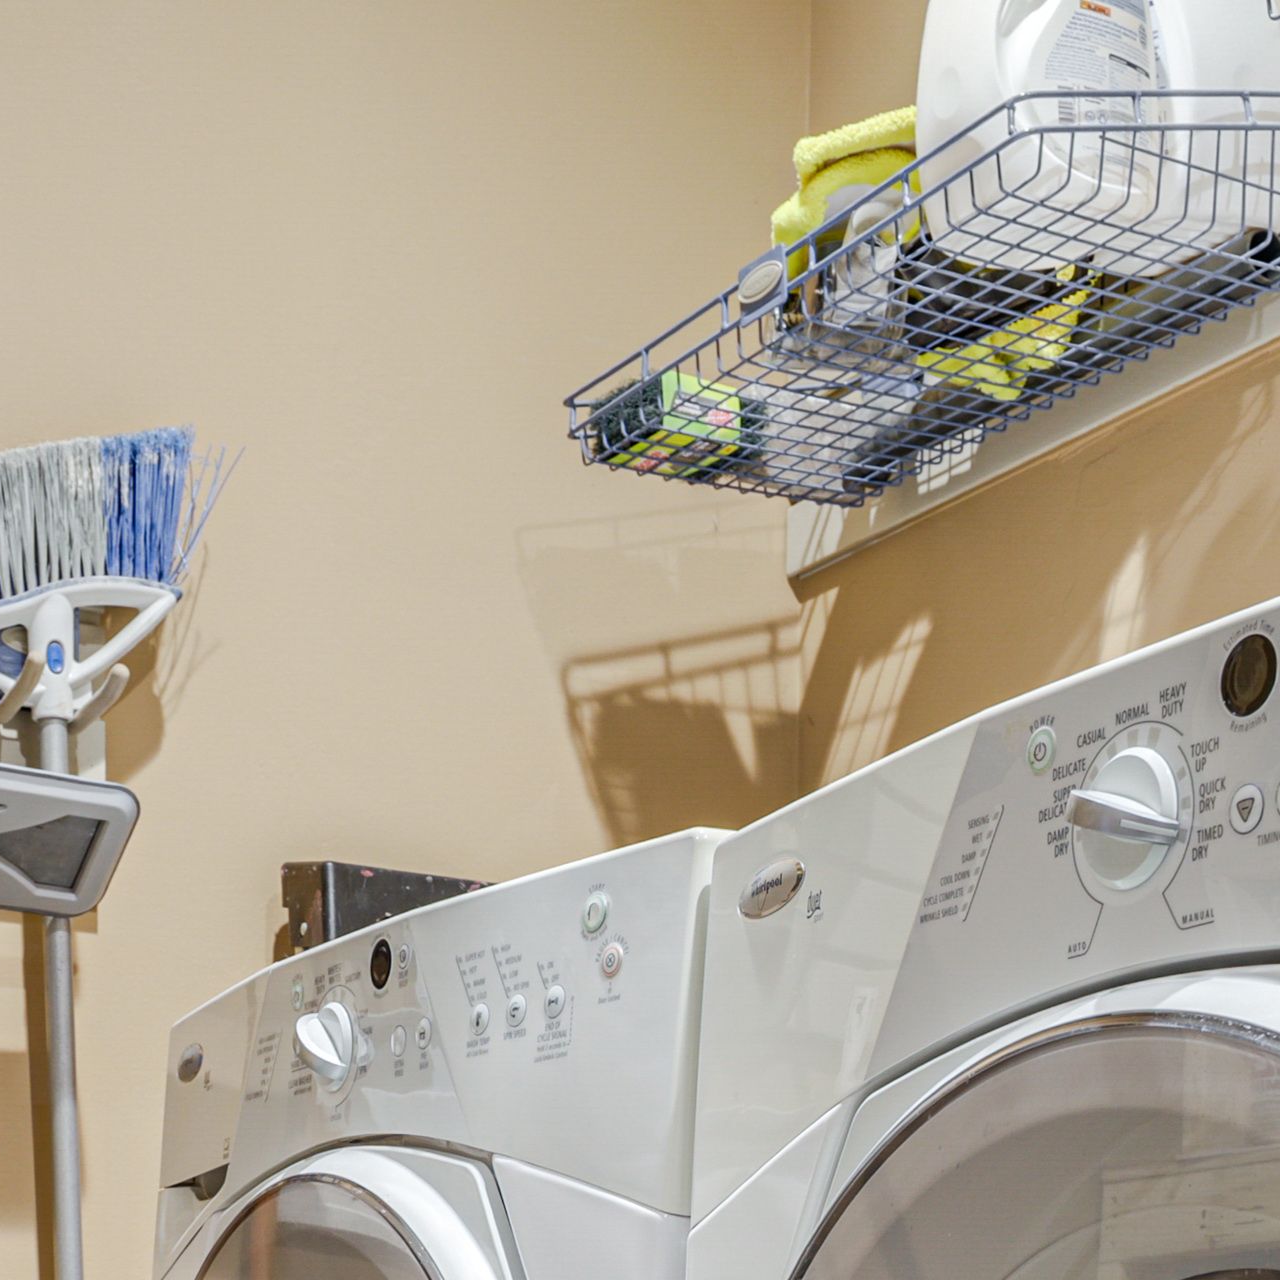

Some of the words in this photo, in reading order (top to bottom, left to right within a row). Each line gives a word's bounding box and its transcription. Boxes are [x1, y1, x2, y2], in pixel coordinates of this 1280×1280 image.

[1159, 682, 1187, 703] HEAVY
[1115, 703, 1150, 726] NORMAL
[1161, 700, 1184, 718] DUTY
[1029, 714, 1055, 734] POWER
[1077, 727, 1106, 748] CASUAL
[1190, 736, 1220, 758] TOUCH
[1052, 758, 1086, 782] DELICATE
[1195, 757, 1207, 773] UP
[1199, 777, 1227, 799] QUICK
[1199, 796, 1217, 814] DRY
[968, 815, 990, 830] SENSING
[972, 833, 983, 844] WET
[1047, 826, 1070, 845] DAMP
[1197, 824, 1224, 844] TIMED
[962, 851, 977, 864] DAMP
[1054, 841, 1069, 858] DRY
[1192, 846, 1209, 862] DRY
[940, 874, 953, 887] COOL
[955, 870, 971, 882] DOWN
[939, 887, 964, 903] COMPLETE
[941, 905, 959, 918] SHIELD
[1182, 908, 1215, 924] MANUAL
[1068, 941, 1087, 953] AUTO
